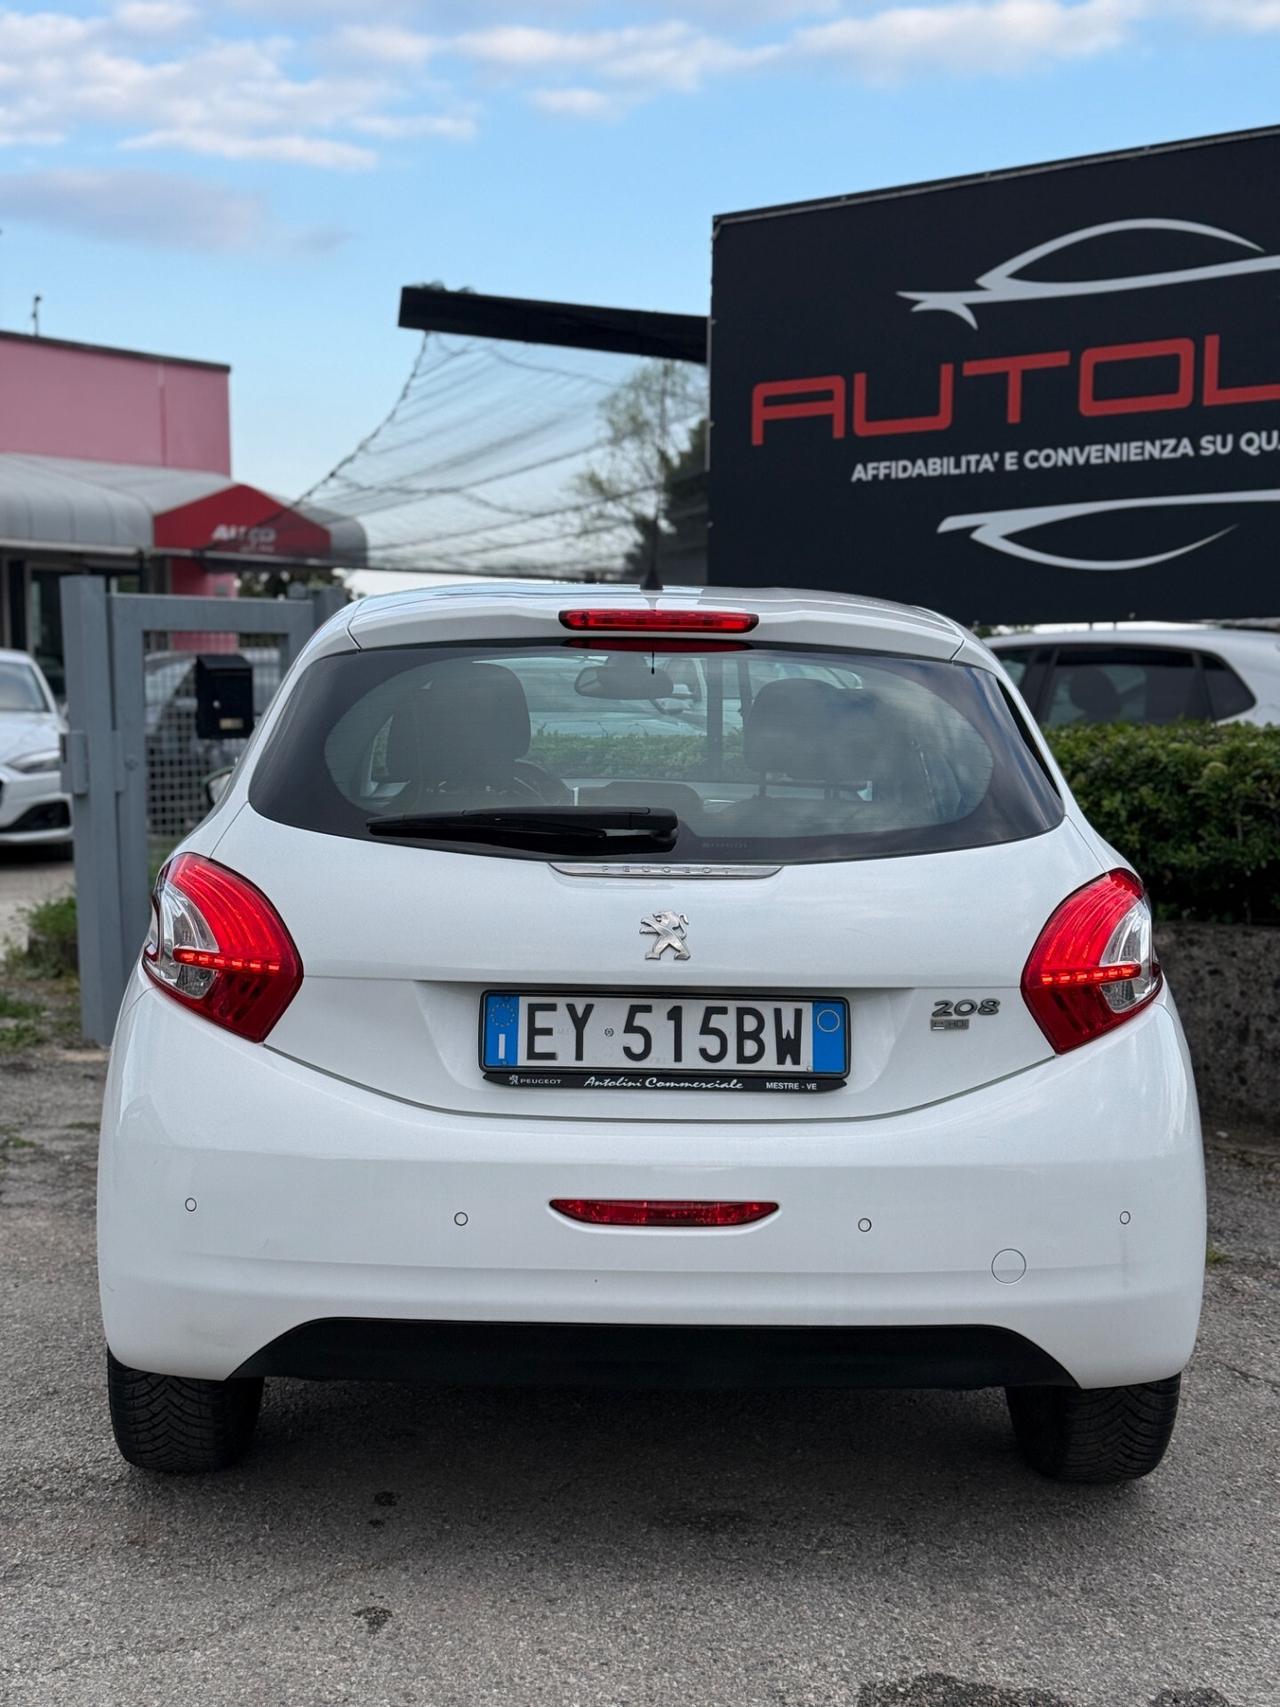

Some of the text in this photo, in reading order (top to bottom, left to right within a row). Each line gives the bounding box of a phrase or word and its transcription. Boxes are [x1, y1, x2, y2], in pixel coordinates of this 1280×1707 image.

[1004, 449, 1018, 471] E
[1023, 436, 1194, 471] CONVENIENZA
[1199, 433, 1234, 456] SU
[1239, 429, 1280, 457] QU
[931, 998, 1001, 1018] 208
[526, 1002, 595, 1061] EY
[622, 1004, 803, 1067] 515BW
[583, 1076, 643, 1088] Antolini
[645, 1077, 744, 1090] Commerciale
[766, 1082, 800, 1091] MESTRE
[806, 1083, 817, 1091] VE
